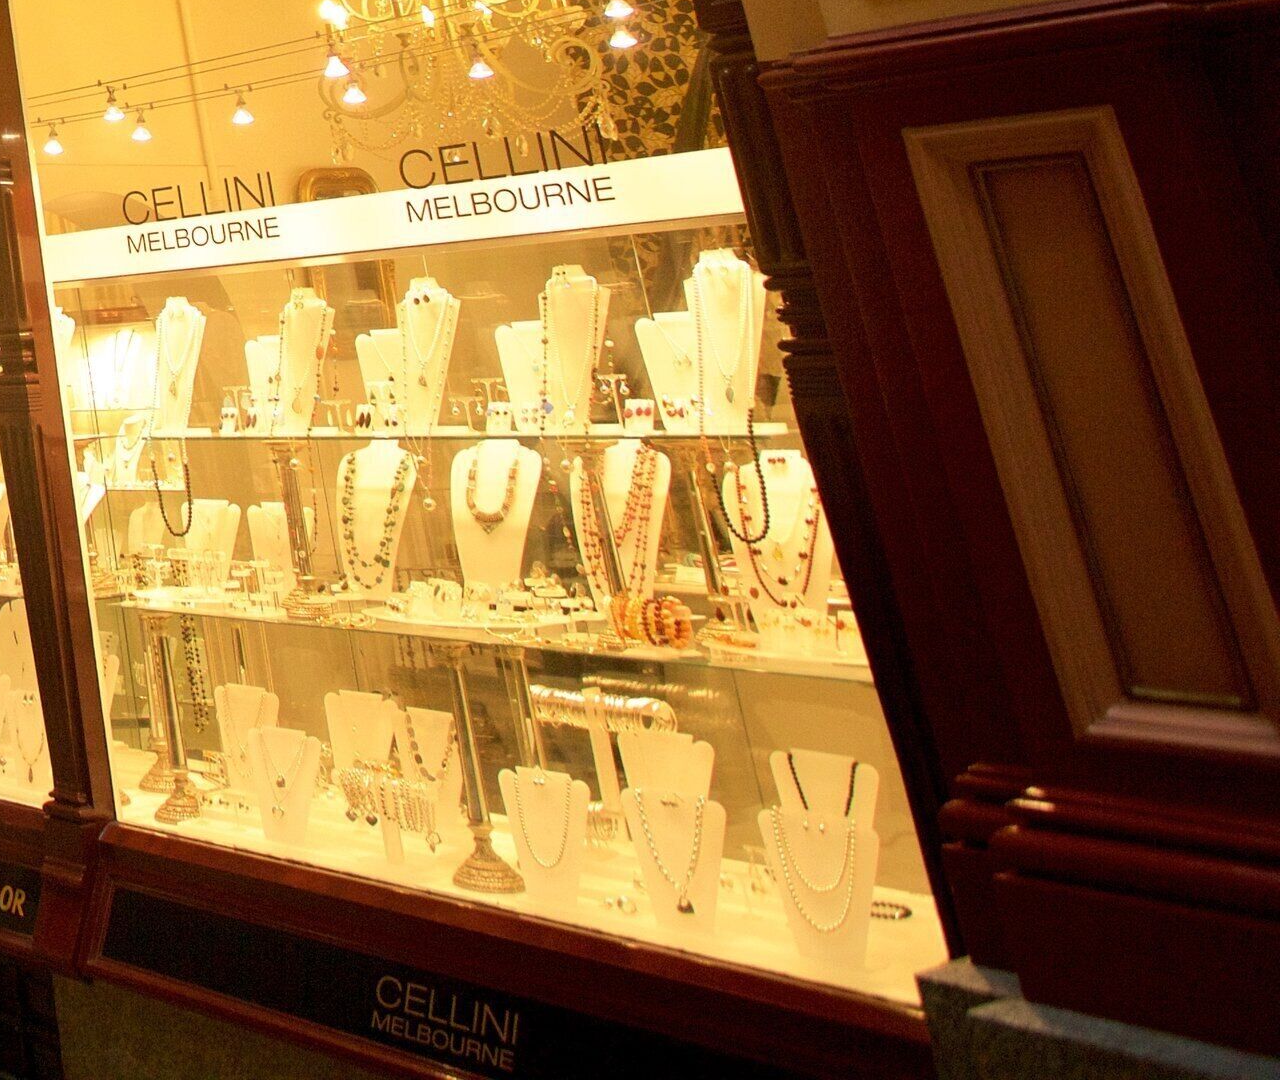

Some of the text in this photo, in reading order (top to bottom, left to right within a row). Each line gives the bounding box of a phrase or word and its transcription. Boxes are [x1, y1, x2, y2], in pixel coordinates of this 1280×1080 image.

[399, 122, 608, 190] CELLINI
[122, 171, 276, 225] CELLINI
[406, 176, 616, 223] MELBOURNE
[126, 217, 280, 254] MELBOURNE
[375, 975, 520, 1045] CELLINI
[367, 1010, 515, 1072] MELBOURNE
